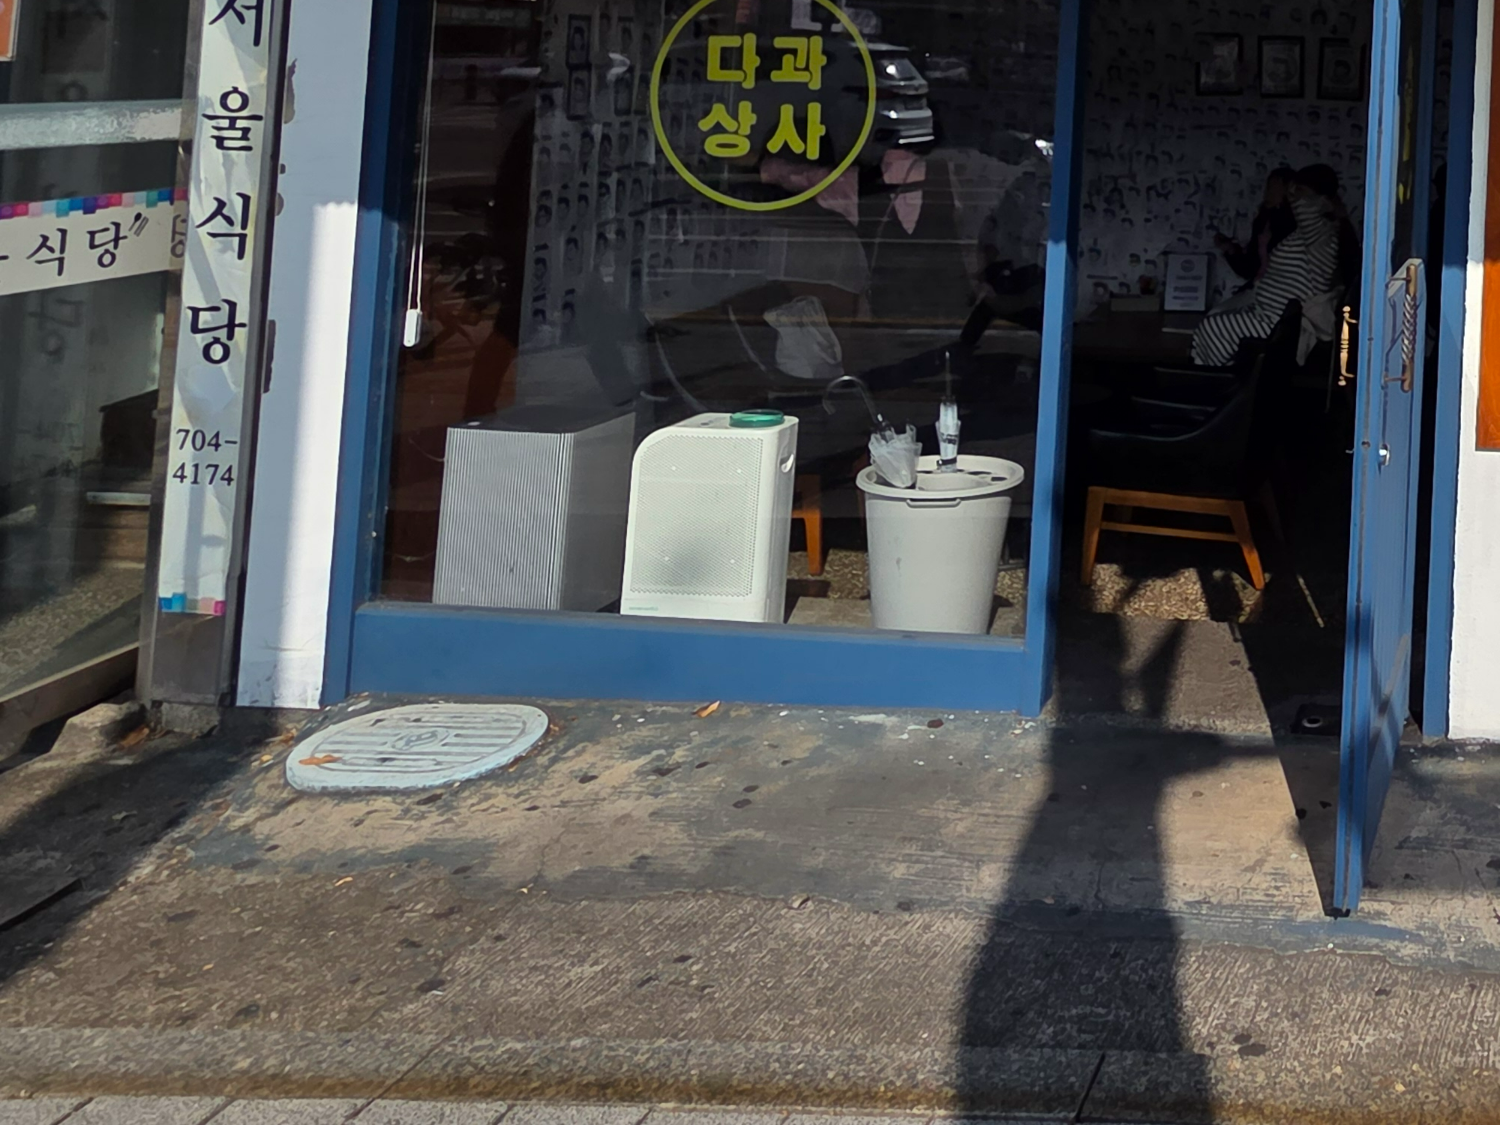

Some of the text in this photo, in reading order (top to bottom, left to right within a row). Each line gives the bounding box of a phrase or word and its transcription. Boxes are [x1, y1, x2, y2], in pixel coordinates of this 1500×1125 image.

[706, 32, 828, 90] 다과
[697, 100, 827, 161] 상사
[0, 221, 129, 277] 식당
[175, 428, 239, 453] 704-
[172, 461, 235, 487] 4174
